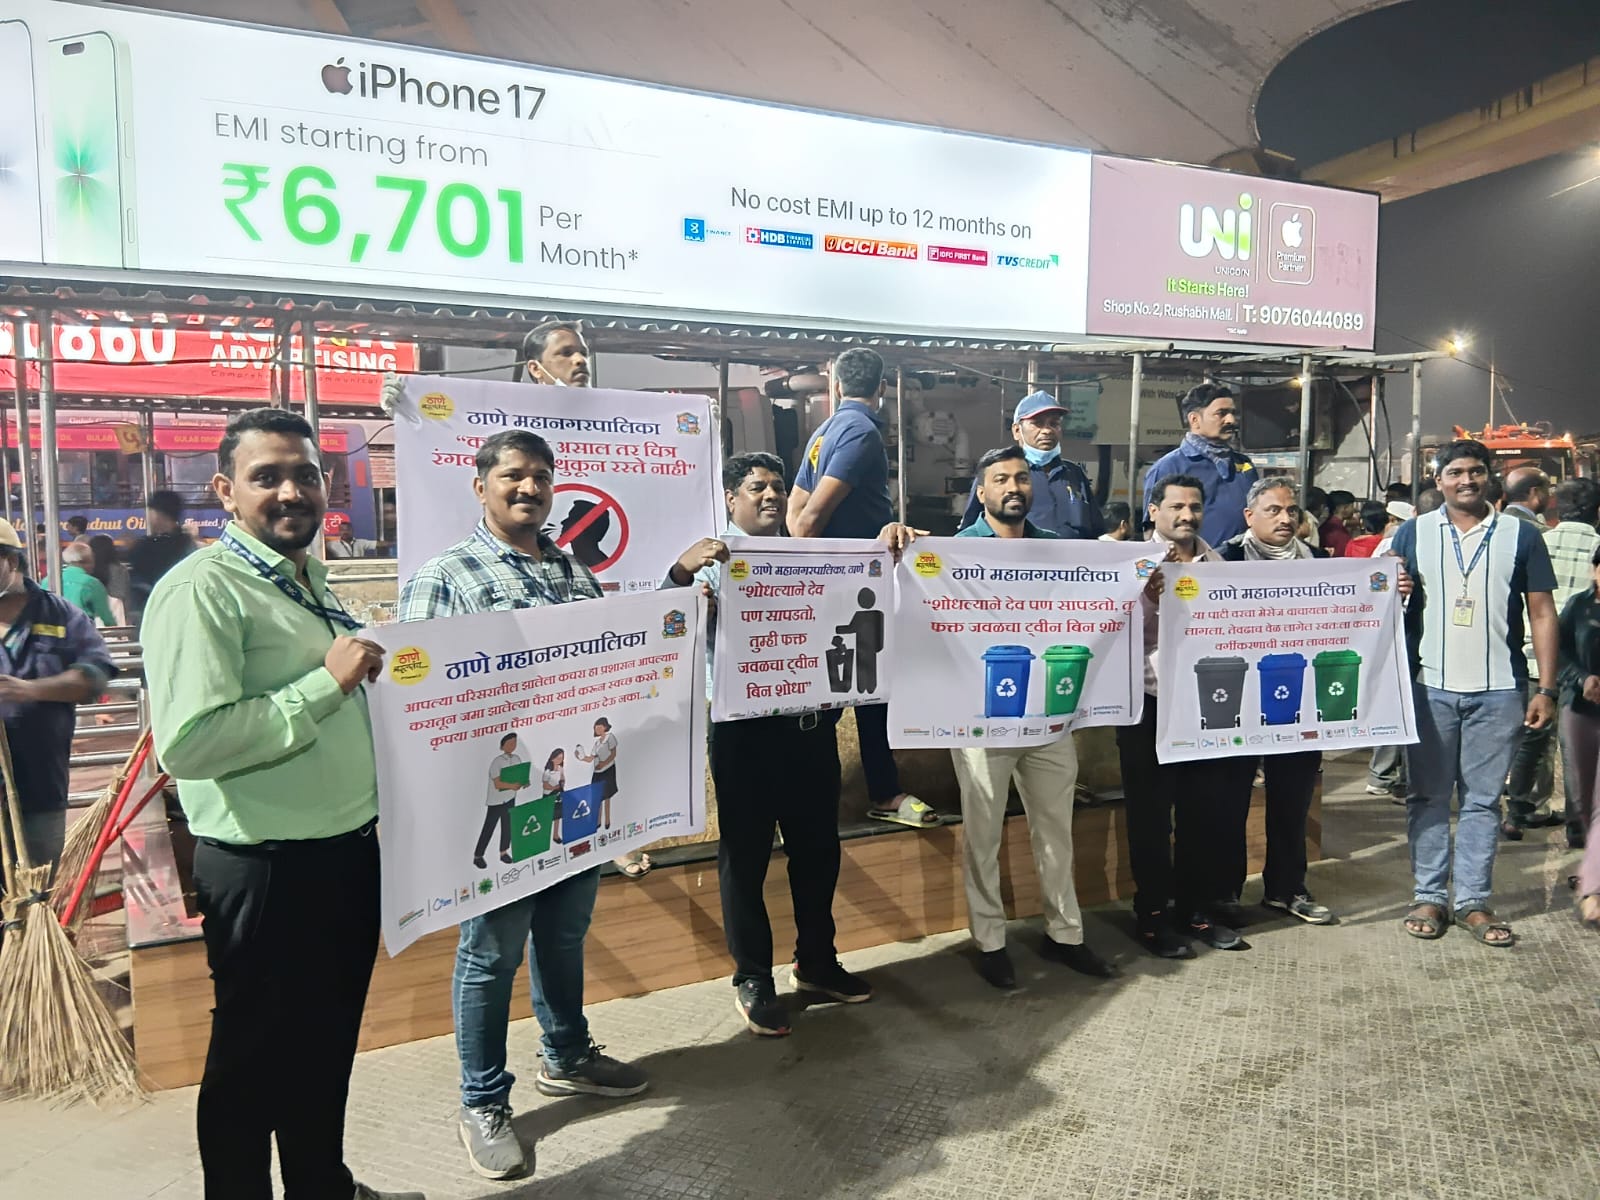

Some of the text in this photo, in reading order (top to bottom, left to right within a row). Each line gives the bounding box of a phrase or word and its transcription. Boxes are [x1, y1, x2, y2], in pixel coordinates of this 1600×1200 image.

[359, 62, 547, 121] iPhone 17
[215, 111, 490, 167] EMI starting from
[222, 162, 525, 264] ₹6,701
[539, 204, 583, 231] Per
[730, 187, 1033, 241] No cost EMI up to 12 months on
[760, 231, 786, 244] HDB
[835, 239, 917, 259] ICICI Bank
[954, 252, 971, 261] FIRST
[1276, 251, 1307, 263] Premium
[1278, 262, 1304, 273] Partner
[1167, 277, 1249, 298] It Starts Here!
[1103, 300, 1132, 316] Shop
[1133, 301, 1152, 315] No.
[1163, 304, 1208, 320] Rushabh
[1242, 304, 1364, 331] T: 9076044089
[467, 408, 662, 435] ठाणे महानगरपालिका
[556, 440, 679, 458] असाल तर चित्र
[611, 457, 648, 474] रस्ते
[752, 562, 773, 577] ठाणे
[848, 561, 865, 575] ठाणे
[952, 563, 1121, 583] ठाणे महानगरपालिका
[807, 580, 825, 597] देव
[1208, 581, 1357, 601] ठाणे महानगरपालिका
[740, 604, 816, 623] पण सापडतो,
[1005, 595, 1025, 612] देव
[1028, 599, 1053, 612] पण
[1192, 611, 1206, 620] या
[1207, 607, 1229, 620] पाटी
[930, 620, 966, 634] फक्त
[968, 620, 1021, 634] जवळचा
[1024, 618, 1062, 637] ट्वीन
[1066, 618, 1096, 633] बिन
[1283, 620, 1313, 632] लागेल
[1352, 619, 1380, 628] कचरा
[749, 630, 808, 653] तुम्ही फक्त
[1280, 639, 1304, 648] सवय
[397, 648, 420, 664] ठाणे
[445, 630, 648, 680] ठाणे महानगरपालिका
[737, 653, 819, 675] जवळचा ट्वीन
[404, 695, 455, 713] आपल्या
[456, 681, 521, 703] परिसरातील
[521, 674, 556, 691] झालेला
[558, 669, 586, 683] कचरा
[588, 666, 599, 678] हा
[600, 660, 636, 674] प्रशासन
[746, 681, 772, 699] बिन
[409, 714, 457, 731] करातून
[460, 708, 486, 722] जमा
[488, 699, 531, 717] झालेल्या
[532, 692, 554, 706] पैसा
[556, 685, 576, 701] खर्च
[578, 682, 606, 696] करून
[608, 677, 634, 690] स्वच्छ
[430, 730, 469, 752] कृपया
[470, 722, 509, 739] आपला
[510, 716, 533, 729] पैसा
[580, 700, 601, 713] जाऊ
[601, 696, 617, 708] देऊ
